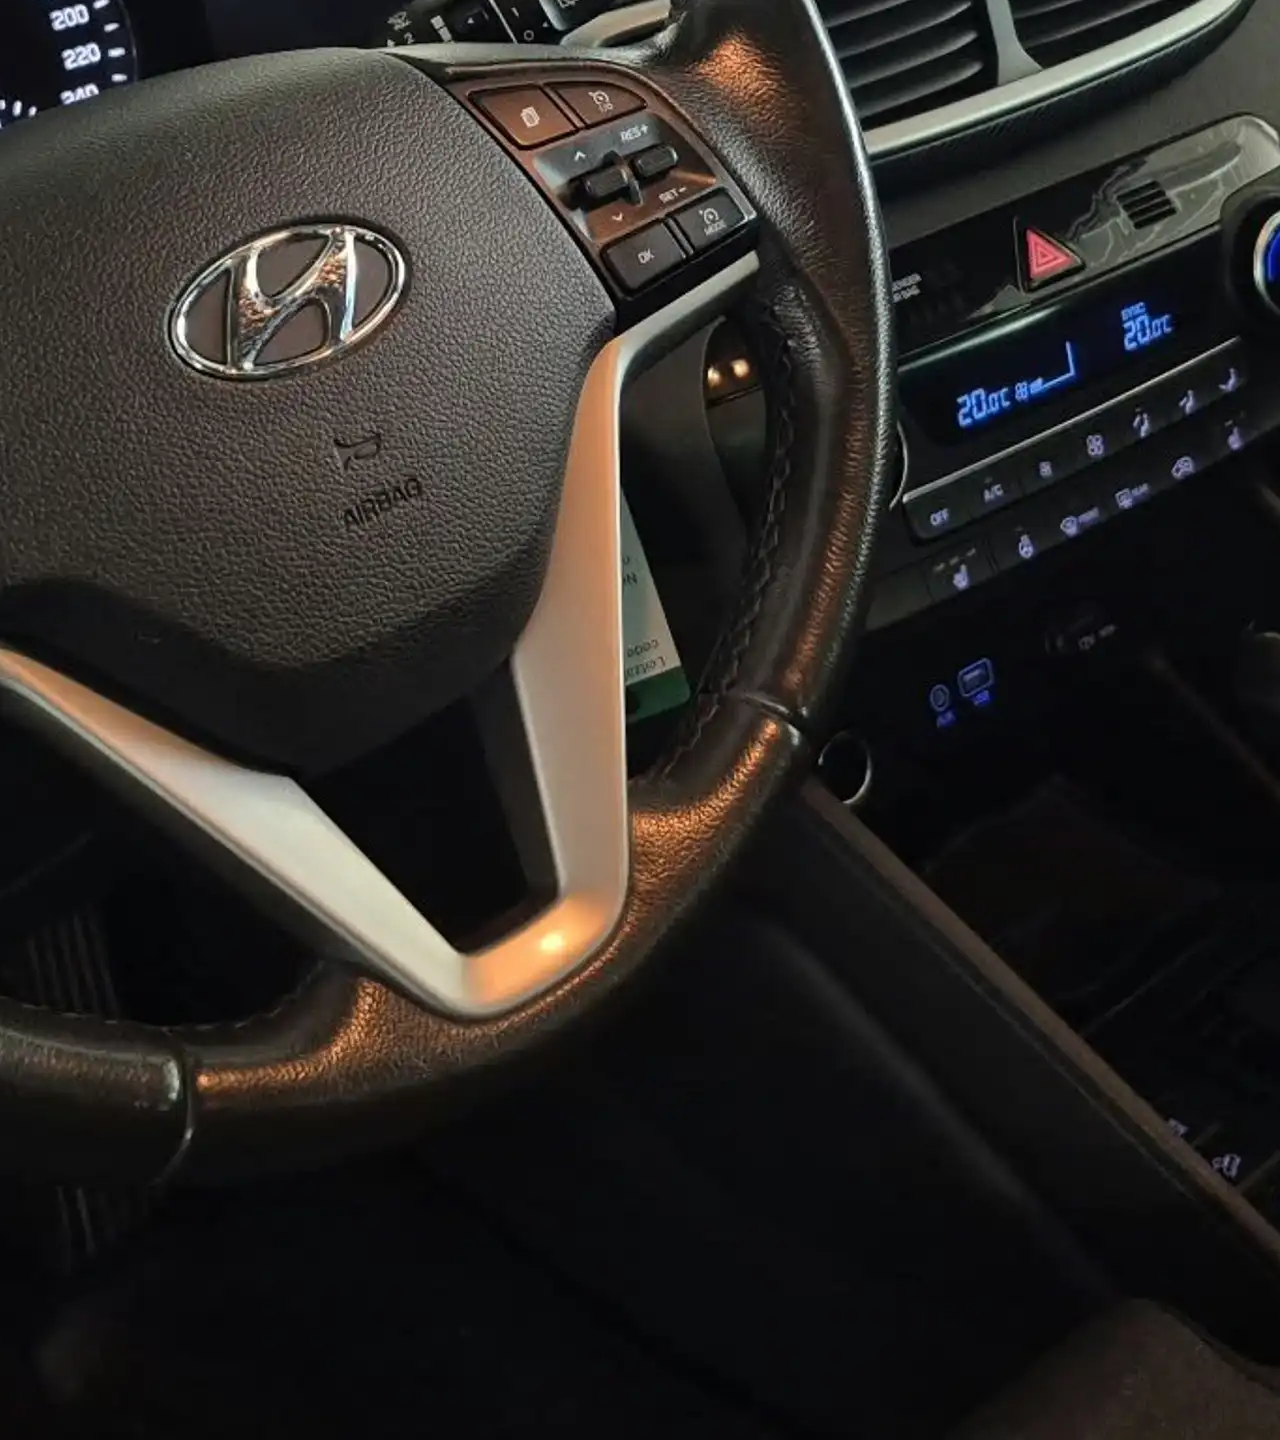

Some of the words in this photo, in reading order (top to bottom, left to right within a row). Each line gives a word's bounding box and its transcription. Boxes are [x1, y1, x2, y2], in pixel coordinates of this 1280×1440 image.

[50, 4, 90, 31] 200
[62, 42, 102, 70] 220
[930, 508, 949, 527] OFF
